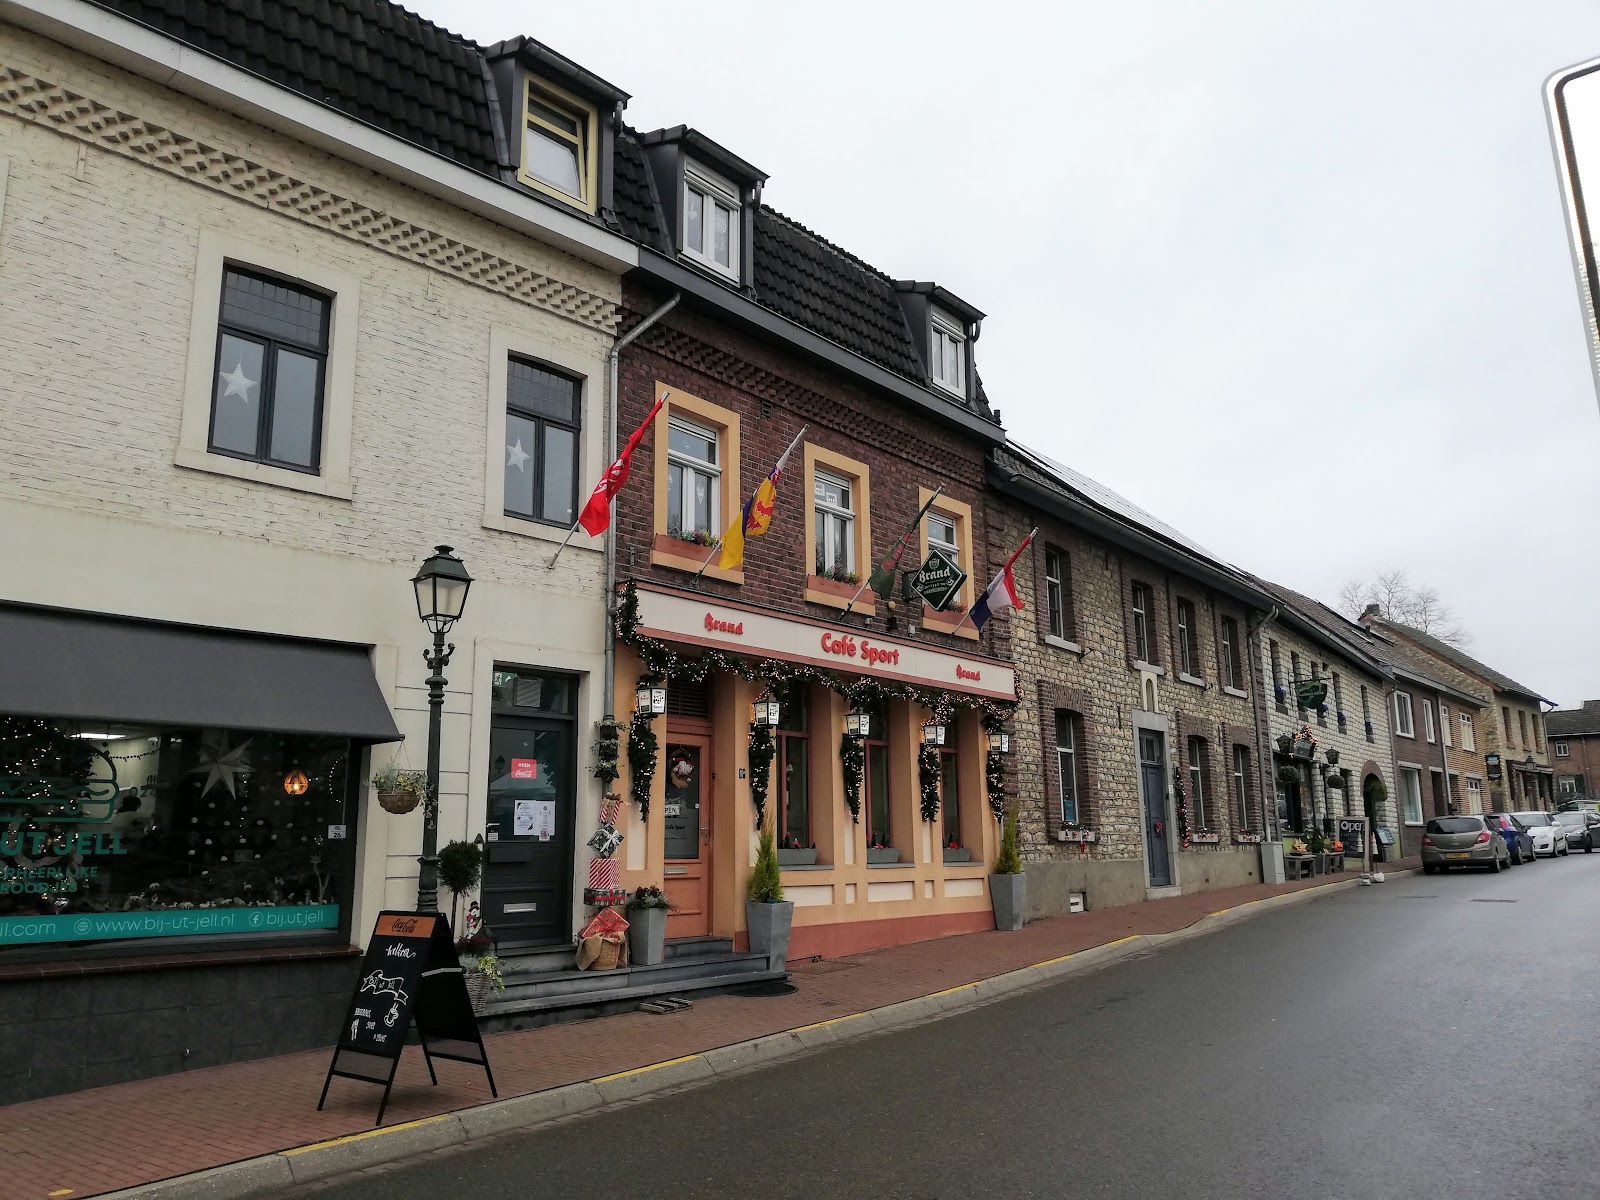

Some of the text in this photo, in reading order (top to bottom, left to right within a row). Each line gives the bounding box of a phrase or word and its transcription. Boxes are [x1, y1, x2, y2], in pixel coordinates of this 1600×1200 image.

[919, 566, 951, 583] Brand
[704, 612, 743, 635] Brand
[821, 632, 899, 666] Café Sport
[956, 664, 981, 681] Brand
[1, 831, 127, 856] UT JELL
[96, 913, 234, 932] www.bij-ut-jell.nl
[267, 910, 324, 927] bij.ut.jell
